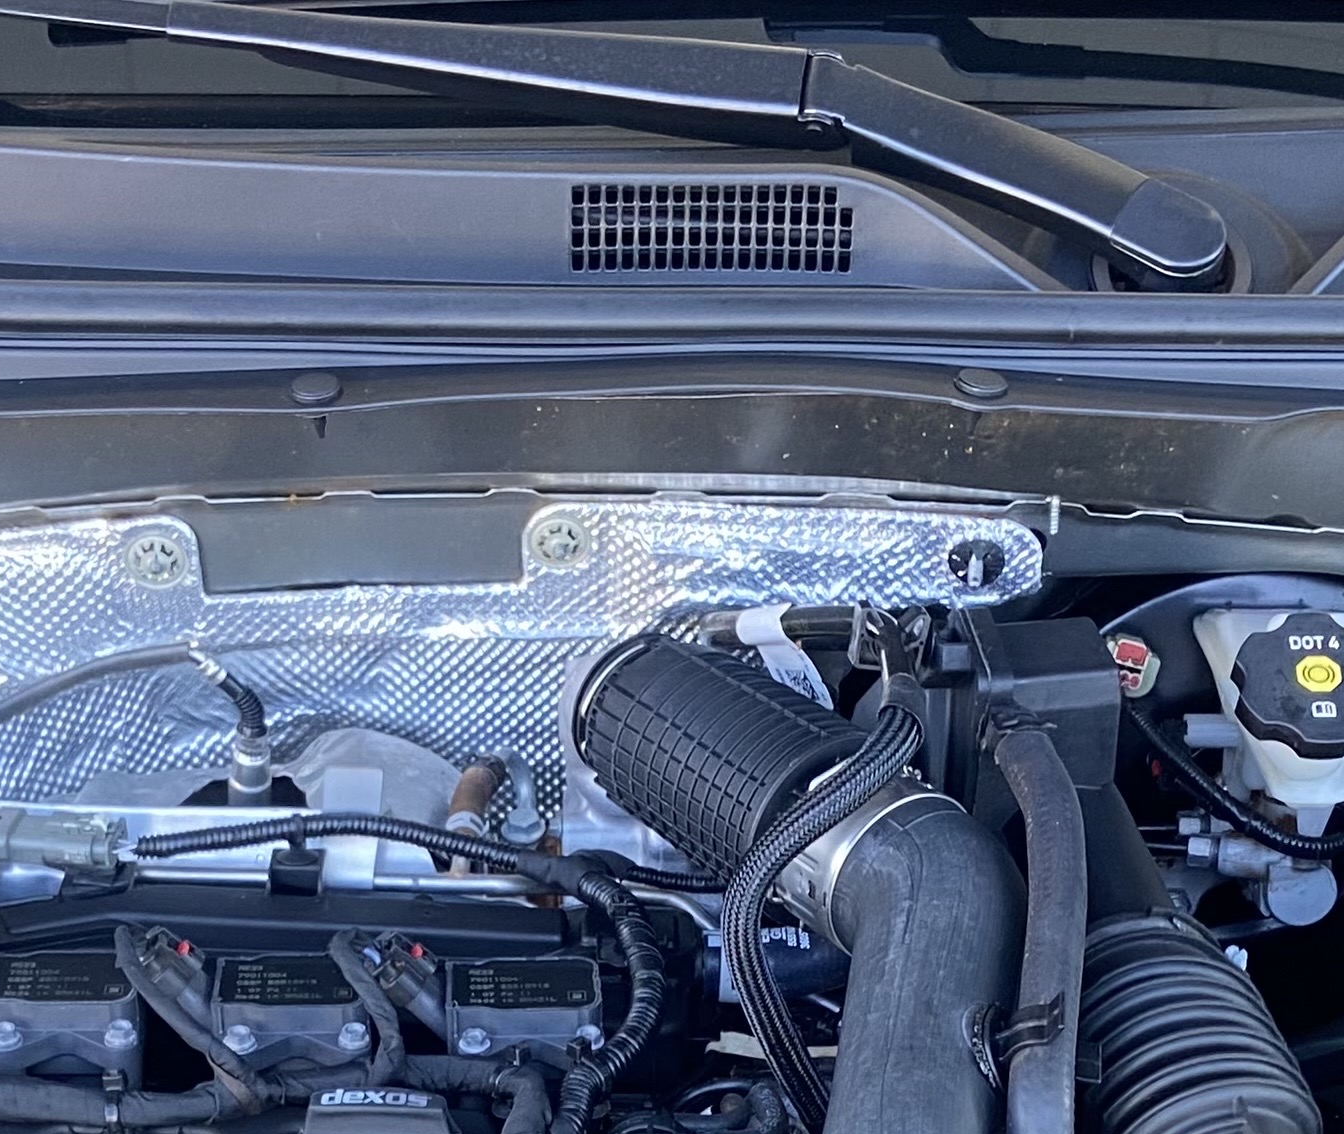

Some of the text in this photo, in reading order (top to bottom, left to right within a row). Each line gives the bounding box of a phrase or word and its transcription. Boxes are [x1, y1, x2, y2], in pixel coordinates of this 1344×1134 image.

[1288, 635, 1340, 650] DOT 4
[321, 1089, 428, 1107] dexos
